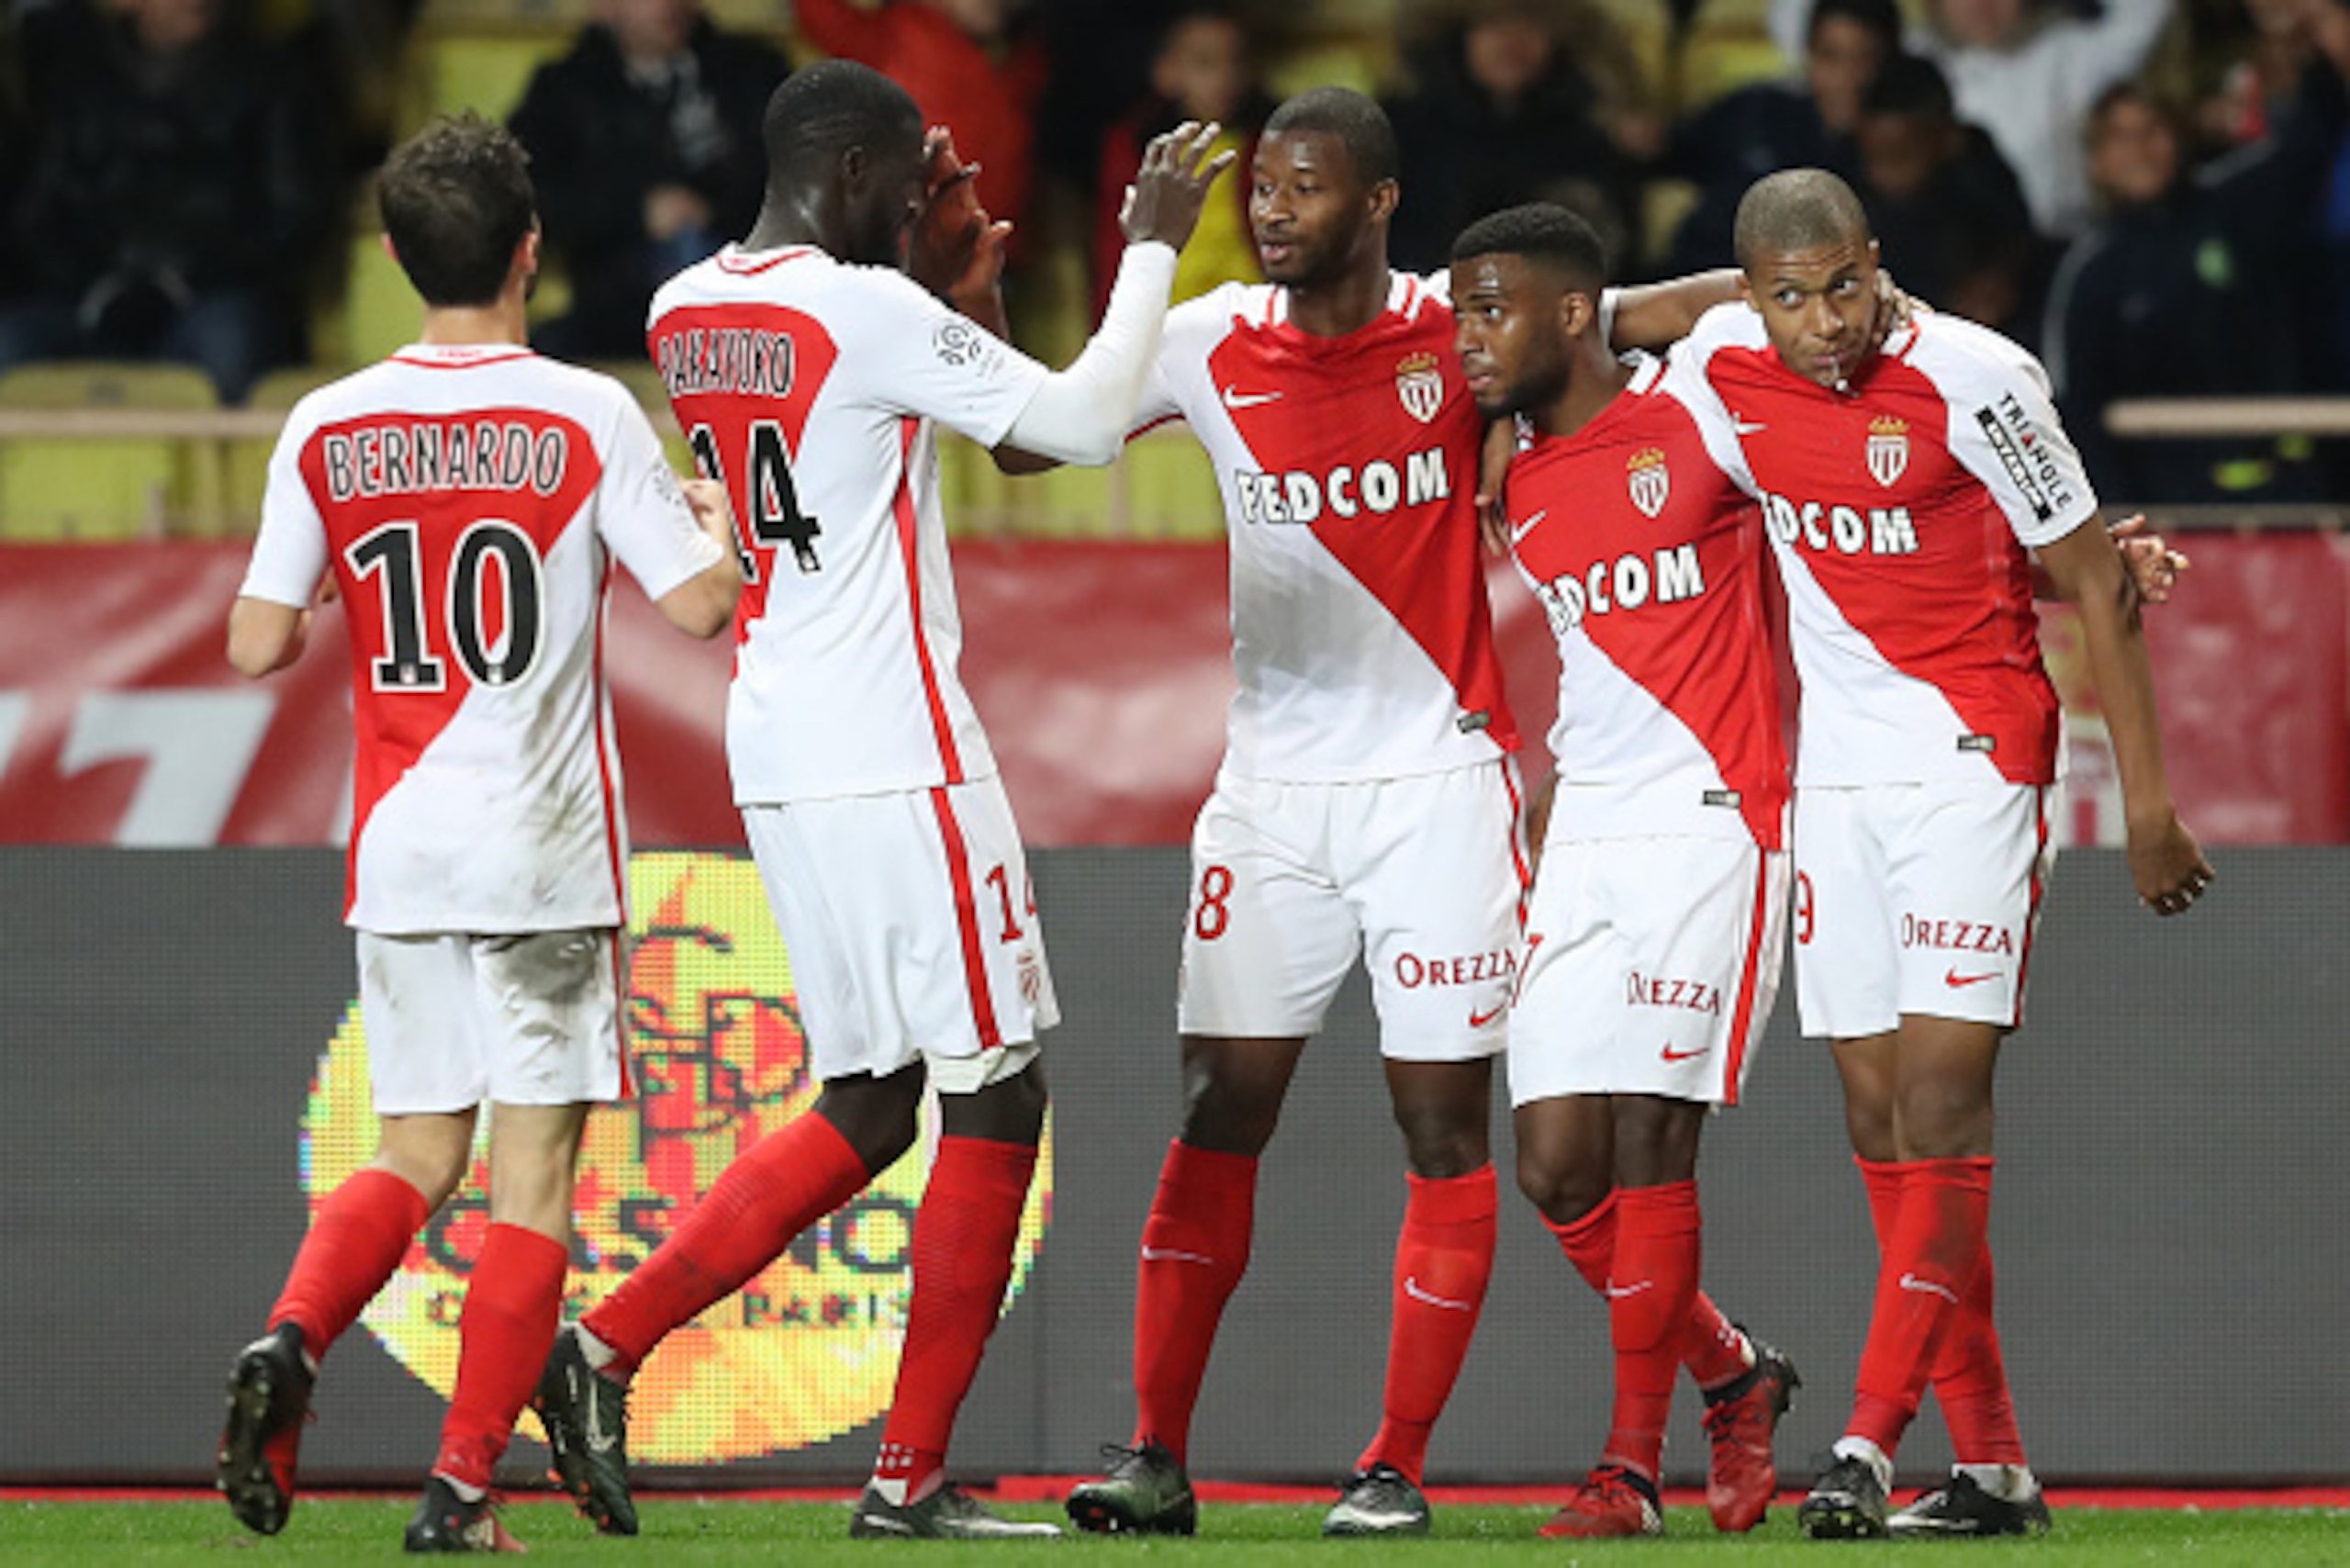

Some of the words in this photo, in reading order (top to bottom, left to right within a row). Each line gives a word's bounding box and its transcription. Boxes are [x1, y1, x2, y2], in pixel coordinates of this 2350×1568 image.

[324, 420, 567, 502] BERNARDO
[342, 518, 545, 693] 10
[1195, 866, 1234, 940] 8
